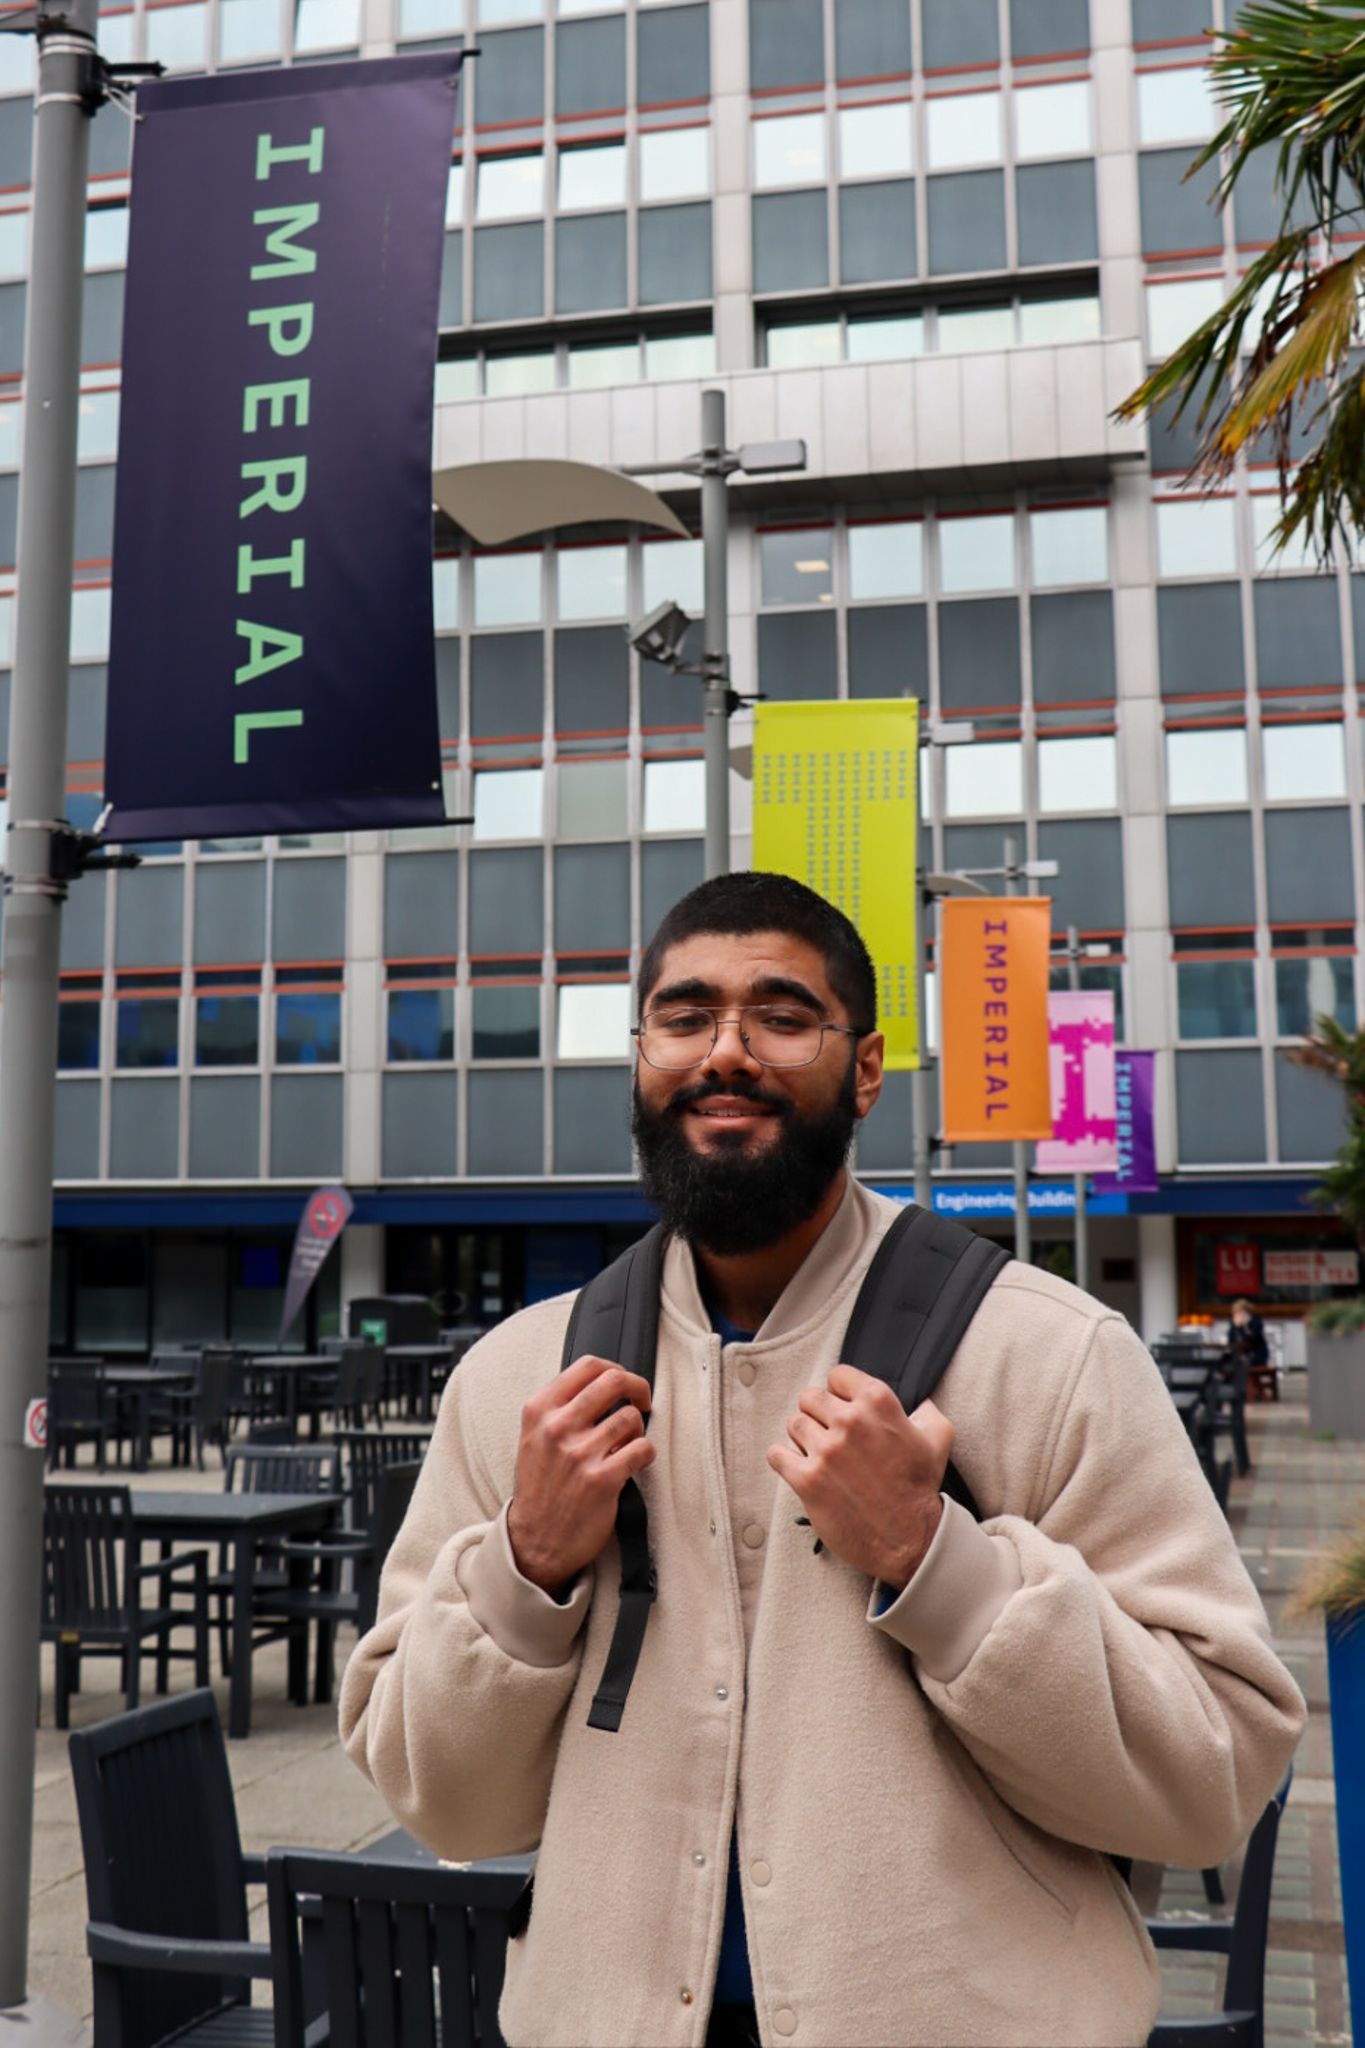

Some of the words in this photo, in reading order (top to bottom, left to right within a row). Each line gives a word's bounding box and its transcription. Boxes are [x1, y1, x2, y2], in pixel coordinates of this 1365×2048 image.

[233, 126, 325, 764] IMPERIAL
[984, 920, 1010, 1120] IMPERIAL
[1115, 1062, 1134, 1183] IMPERIAL
